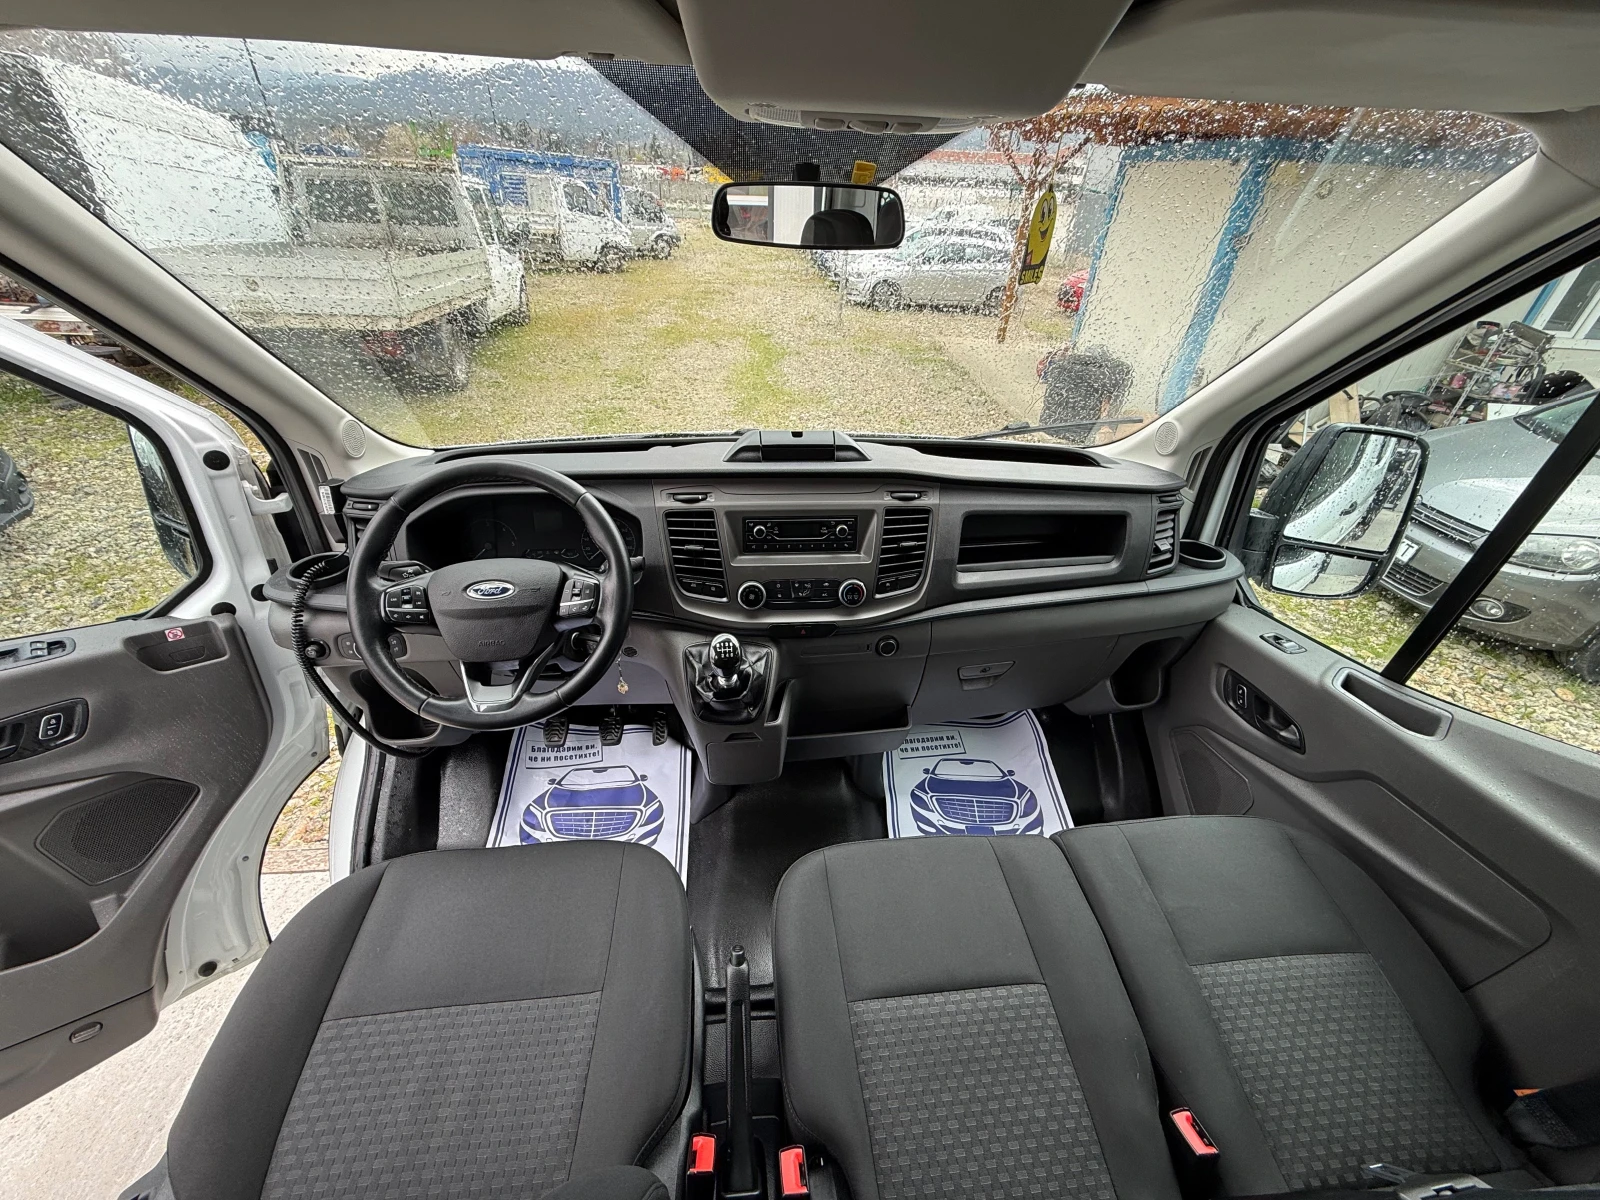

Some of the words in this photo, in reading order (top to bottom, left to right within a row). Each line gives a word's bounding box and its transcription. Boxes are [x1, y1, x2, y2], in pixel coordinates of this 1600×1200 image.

[477, 585, 502, 595] Ford
[478, 639, 506, 647] AIRBAG
[902, 736, 945, 744] лагодарим
[531, 745, 583, 753] Благодарим
[553, 750, 600, 761] посетихте!
